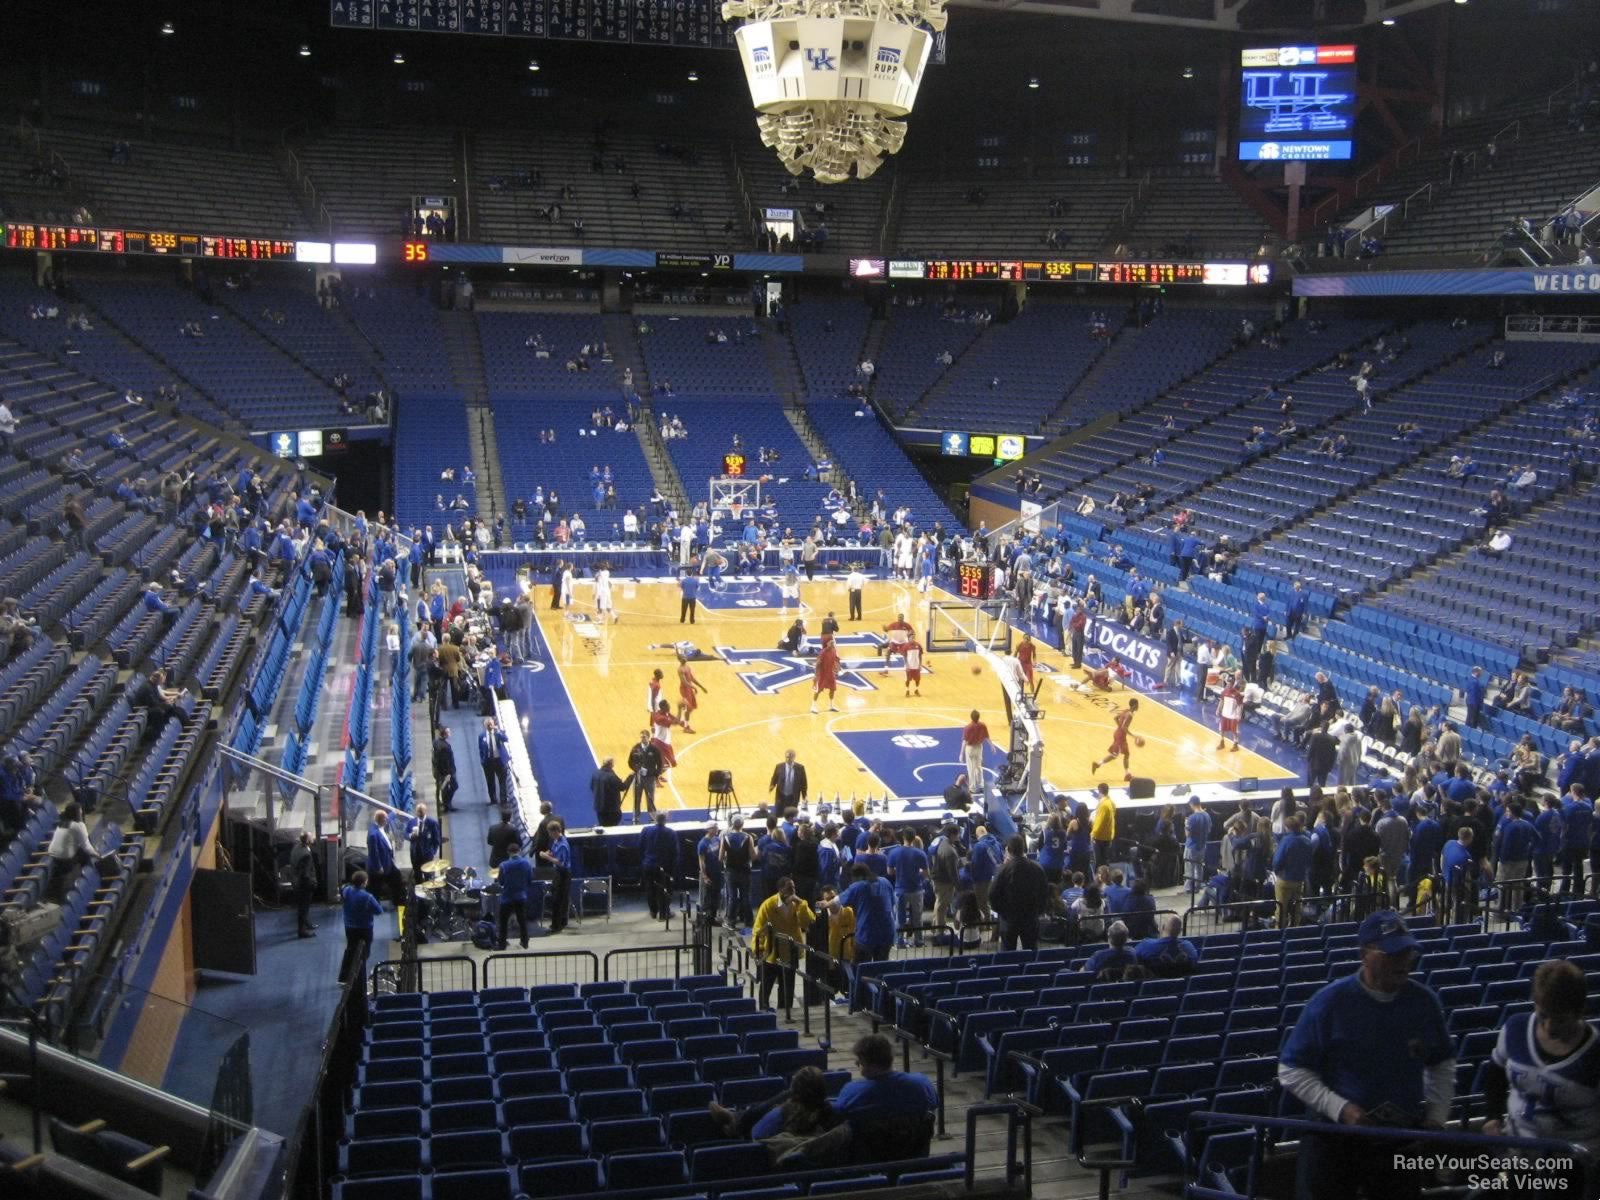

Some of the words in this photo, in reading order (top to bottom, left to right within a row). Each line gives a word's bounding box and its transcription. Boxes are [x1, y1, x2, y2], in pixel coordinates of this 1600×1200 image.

[362, 0, 371, 24] 42
[535, 0, 544, 33] 958
[804, 48, 837, 71] UK
[755, 63, 772, 73] RUPP
[874, 63, 898, 73] RUPP
[1282, 145, 1330, 153] NEWTOWN
[150, 233, 176, 247] 53:55
[405, 244, 427, 260] 35
[540, 254, 570, 262] verizon
[714, 254, 730, 266] yp
[1046, 263, 1072, 274] 53:55
[1533, 274, 1600, 291] WELCO
[728, 464, 741, 474] 35
[960, 565, 982, 579] 53:55
[1084, 618, 1161, 669] LDCATS
[1051, 837, 1060, 849] 3
